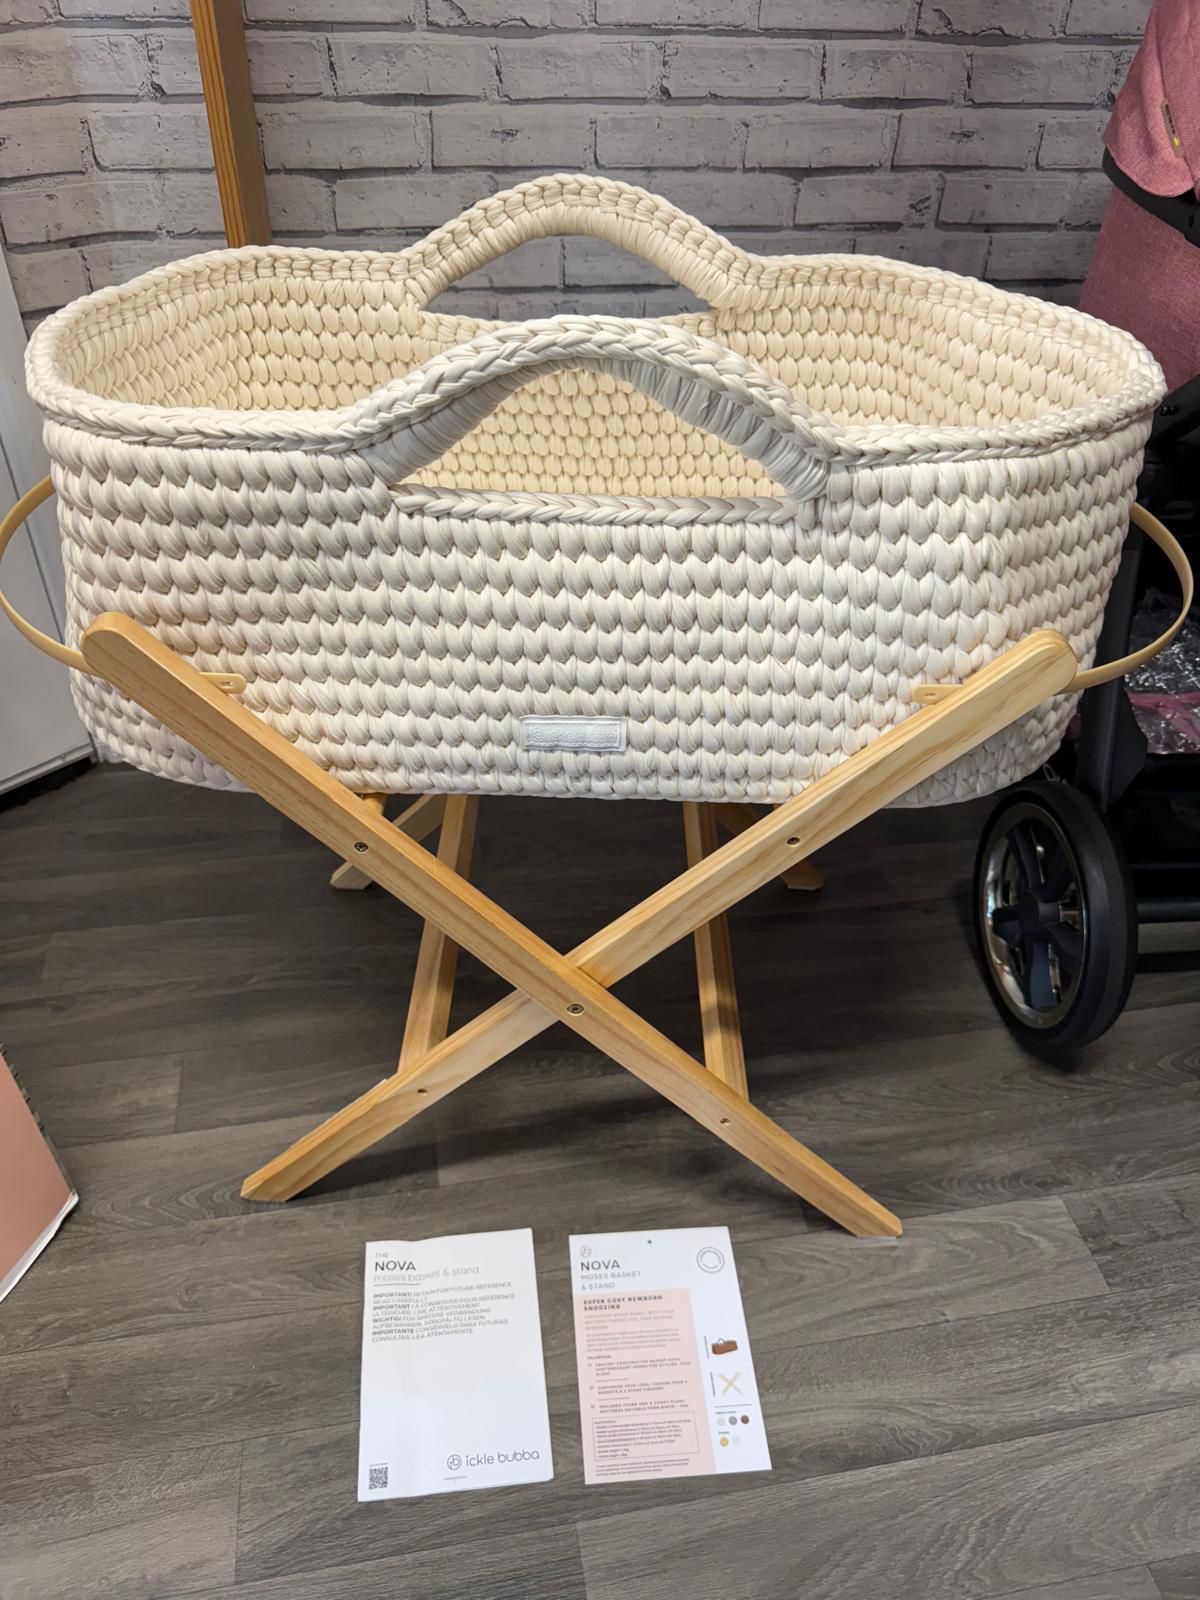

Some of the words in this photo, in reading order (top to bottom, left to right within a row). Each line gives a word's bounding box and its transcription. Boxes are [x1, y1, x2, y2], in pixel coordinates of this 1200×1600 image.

[374, 1260, 417, 1272] NOVA
[580, 1259, 621, 1271] NOVA
[373, 1273, 406, 1282] moses
[408, 1270, 440, 1282] basket
[443, 1268, 450, 1277] &
[452, 1265, 480, 1276] stand
[580, 1272, 609, 1280] MOSES
[610, 1270, 641, 1279] BASKET
[588, 1282, 615, 1290] STAND
[627, 1294, 663, 1302] NEWBORN
[465, 1453, 495, 1467] ickle
[497, 1449, 540, 1463] bubba
